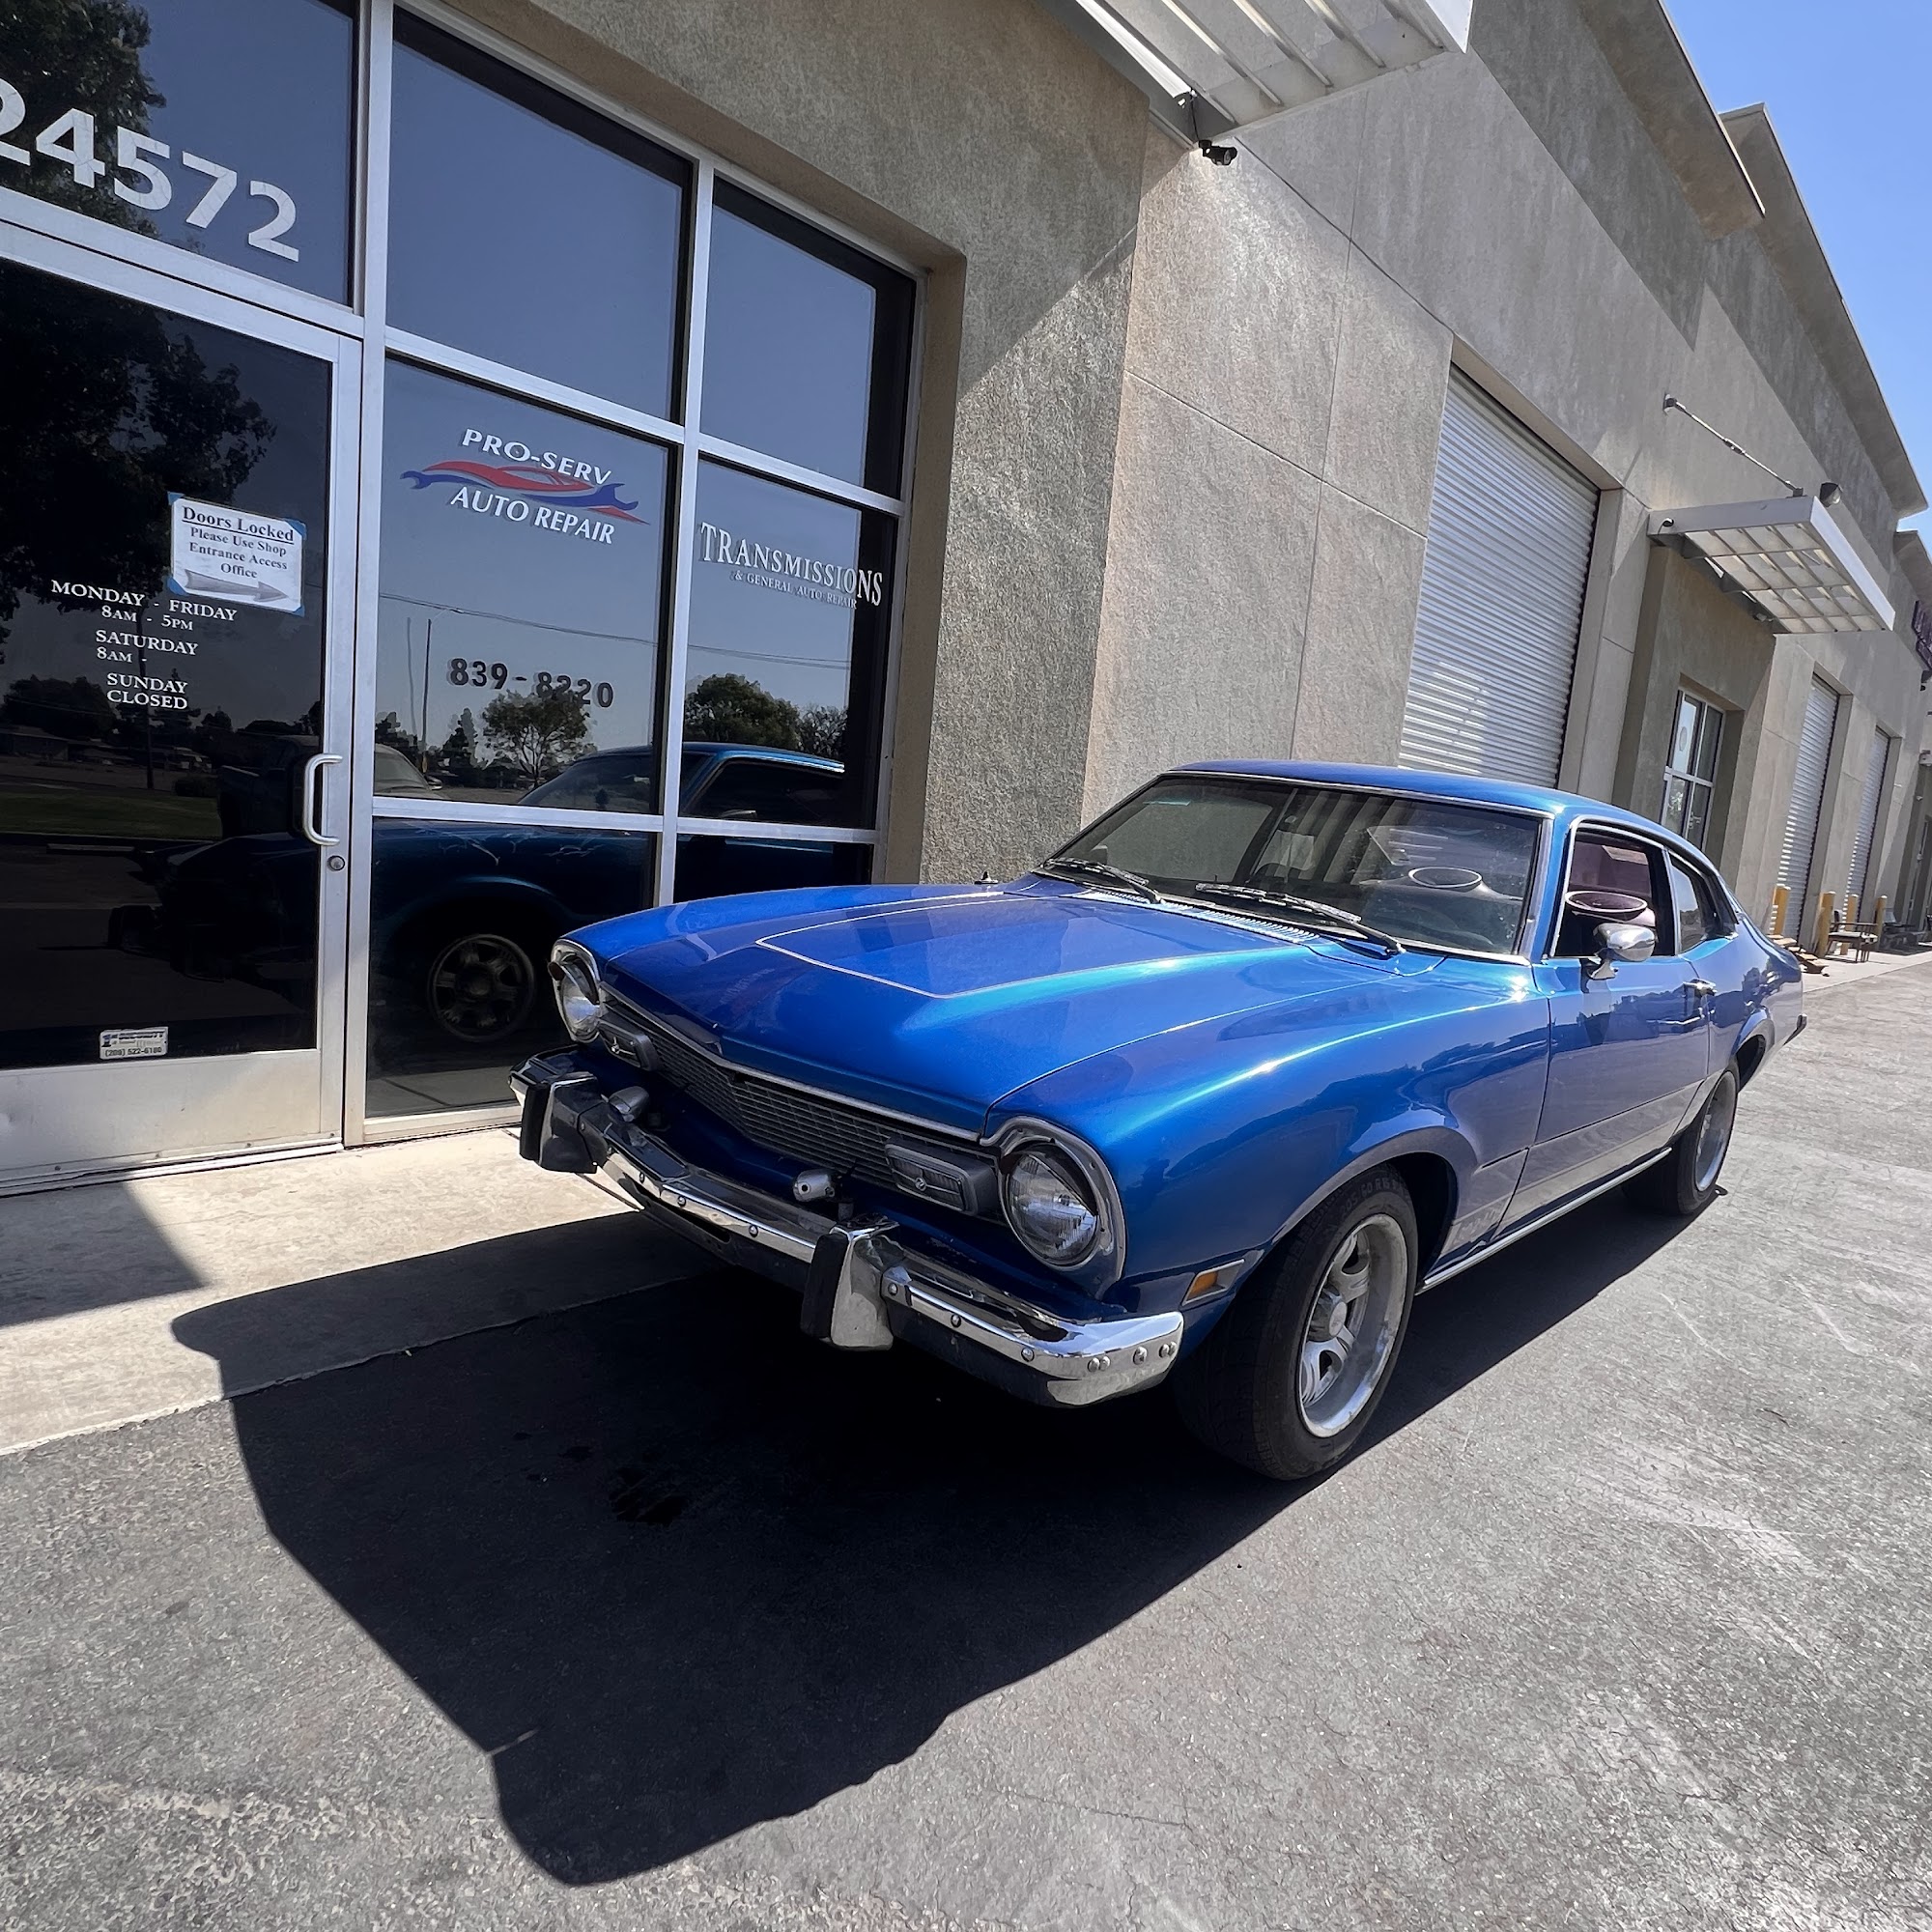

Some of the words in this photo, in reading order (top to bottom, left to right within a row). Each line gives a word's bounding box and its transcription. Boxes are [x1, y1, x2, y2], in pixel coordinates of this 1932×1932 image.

[0, 77, 298, 262] 24572
[462, 429, 611, 485] PRO-SERV
[183, 506, 232, 528] Doors
[238, 518, 294, 541] Locked
[450, 487, 528, 522] AUTO
[534, 507, 615, 544] REPAIR
[189, 542, 245, 561] Entrance
[249, 554, 288, 570] Access
[190, 527, 229, 543] Please
[233, 535, 254, 549] Use
[257, 541, 287, 557] Shop
[220, 563, 258, 579] Office
[700, 522, 883, 607] TRANSMISSIONS
[51, 580, 145, 607] MONDAY
[169, 599, 238, 621] FRIDAY
[734, 570, 743, 581] &
[747, 573, 791, 592] GENERAL
[797, 585, 822, 600] AUTO
[827, 592, 857, 610] REPAIR
[101, 606, 137, 622] 8AM
[161, 614, 193, 631] 5PM
[96, 630, 199, 655] SATURDAY
[97, 646, 132, 663] 8AM
[107, 672, 188, 694] SUNDAY
[106, 690, 188, 710] CLOSED
